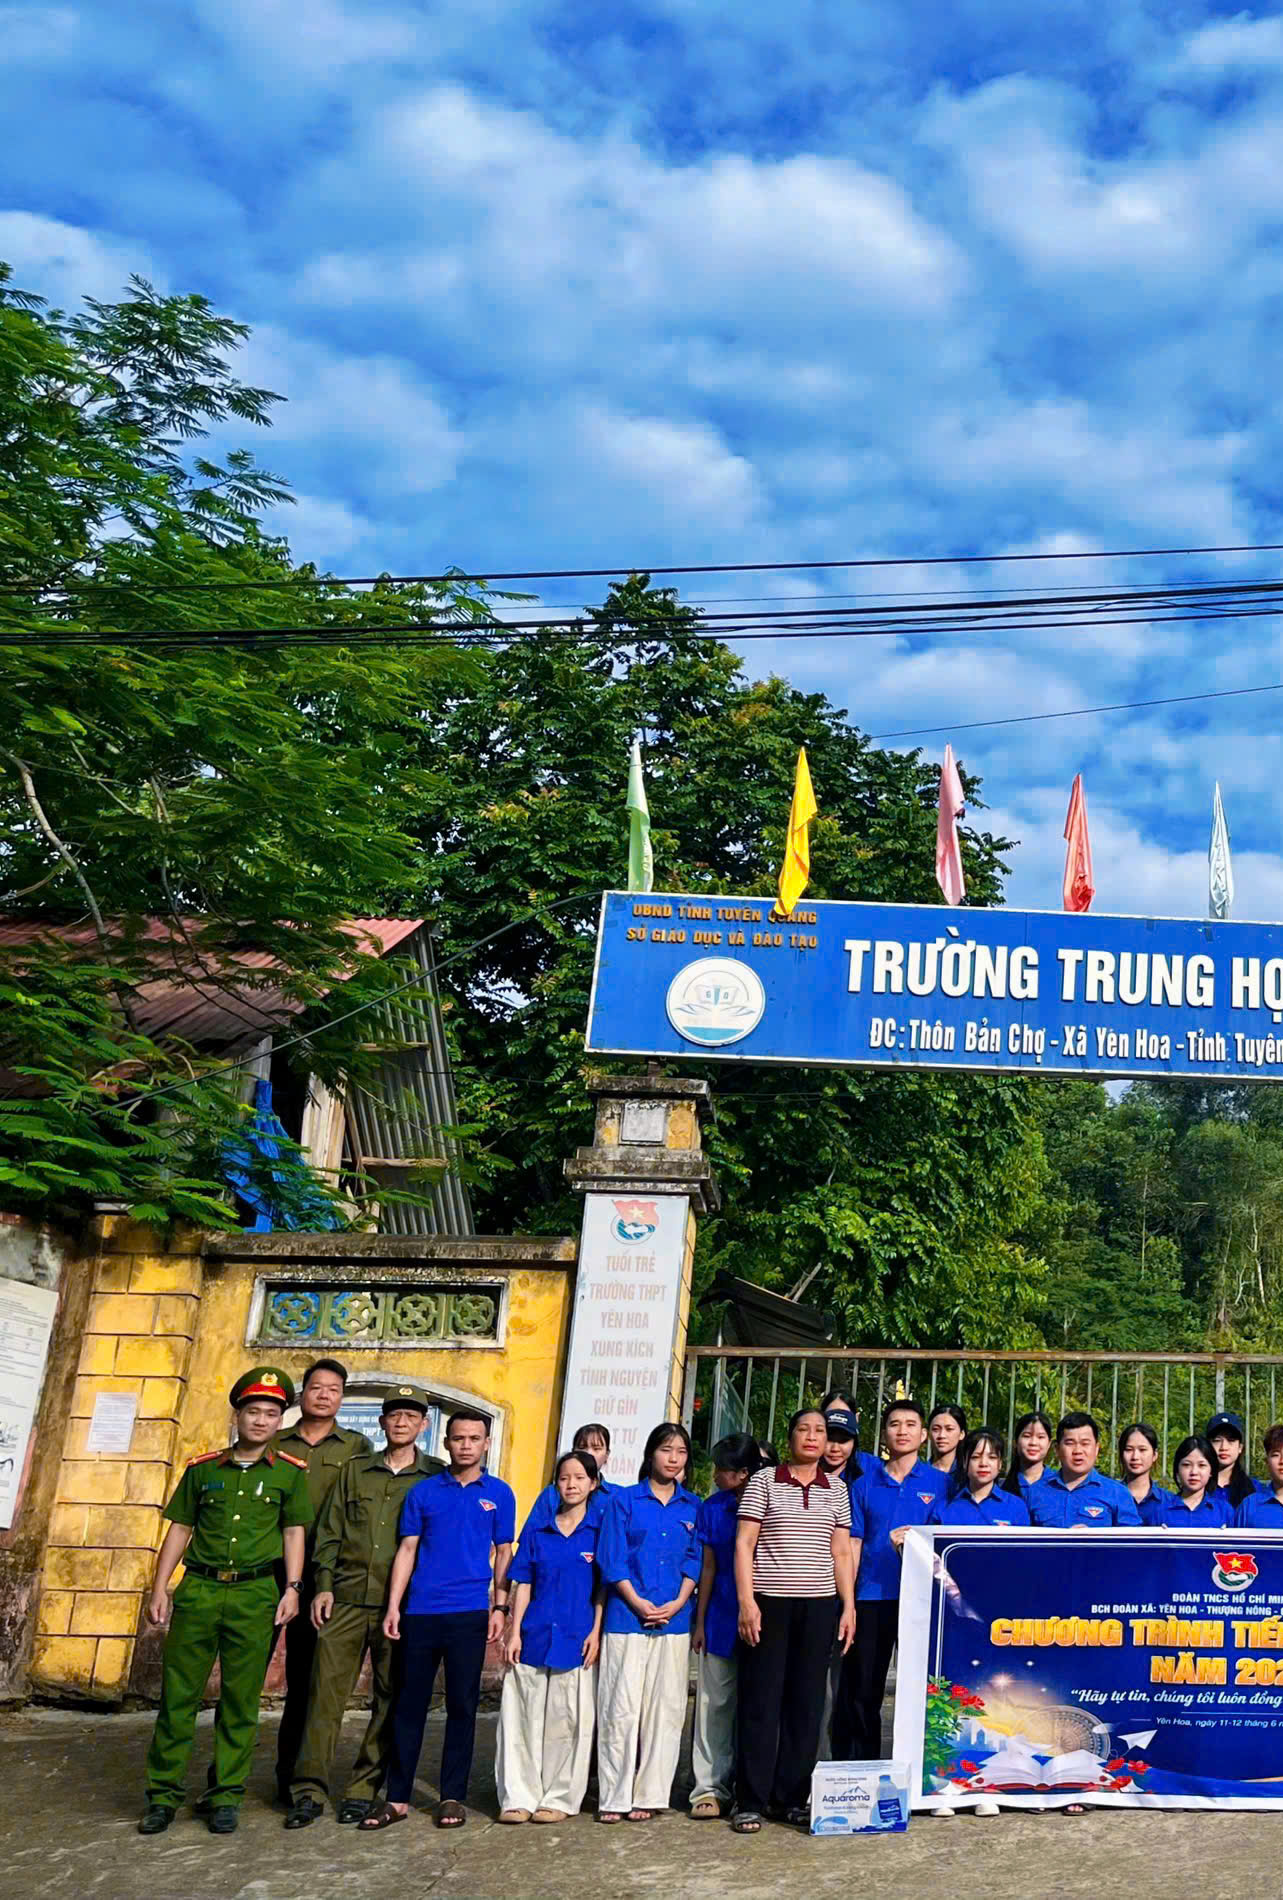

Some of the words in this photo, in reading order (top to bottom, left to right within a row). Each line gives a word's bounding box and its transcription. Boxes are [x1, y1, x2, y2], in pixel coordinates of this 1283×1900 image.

[633, 904, 673, 917] UBND
[679, 902, 711, 919] TỈNH
[716, 905, 761, 922] TUYÊN
[626, 924, 647, 941] SỞ
[652, 927, 686, 942] GIÁO
[693, 931, 722, 948] DỤC
[728, 930, 745, 946] VÀ
[753, 931, 783, 947] ĐÀO
[789, 935, 818, 952] TẠO
[844, 926, 1039, 999] TRƯỜNG
[1057, 948, 1215, 1007] TRUNG
[965, 1017, 1000, 1052] Bản
[1008, 1023, 1046, 1063] Chợ
[1135, 1029, 1171, 1060] Hoa
[635, 1251, 657, 1273] TRẺ
[589, 1280, 635, 1301] TRƯỜNG
[639, 1284, 667, 1302] THPT
[601, 1309, 623, 1328] YÊN
[626, 1312, 649, 1329] HOA
[590, 1340, 623, 1358] XUNG
[580, 1365, 607, 1386] TÌNH
[610, 1368, 658, 1390] NGUYỆN
[1172, 1592, 1200, 1603] ĐOÀN
[1203, 1593, 1229, 1603] TNCS
[1249, 1593, 1265, 1604] CHÍ
[1091, 1604, 1110, 1614] BCH
[1113, 1603, 1139, 1614] ĐOÀN
[1141, 1602, 1156, 1614] XÃ:
[1159, 1603, 1177, 1614] YÊN
[1178, 1605, 1198, 1614] HOA
[1207, 1605, 1243, 1616] THƯỢNG
[990, 1616, 1123, 1646] CHƯƠNG
[1129, 1615, 1224, 1648] TRÌNH
[1150, 1651, 1227, 1684] NĂM
[1111, 1690, 1126, 1704] tự
[1128, 1690, 1150, 1702] tin,
[1154, 1690, 1193, 1706] chúng
[1197, 1691, 1215, 1704] tôi
[1217, 1691, 1246, 1704] luôn
[1249, 1690, 1282, 1708] đồng
[1156, 1717, 1171, 1725] Yên
[1173, 1717, 1192, 1726] Hoa,
[1195, 1718, 1217, 1727] ngày
[1220, 1719, 1242, 1727] 11-12
[1244, 1719, 1268, 1728] tháng
[822, 1794, 870, 1804] Aquaroma
